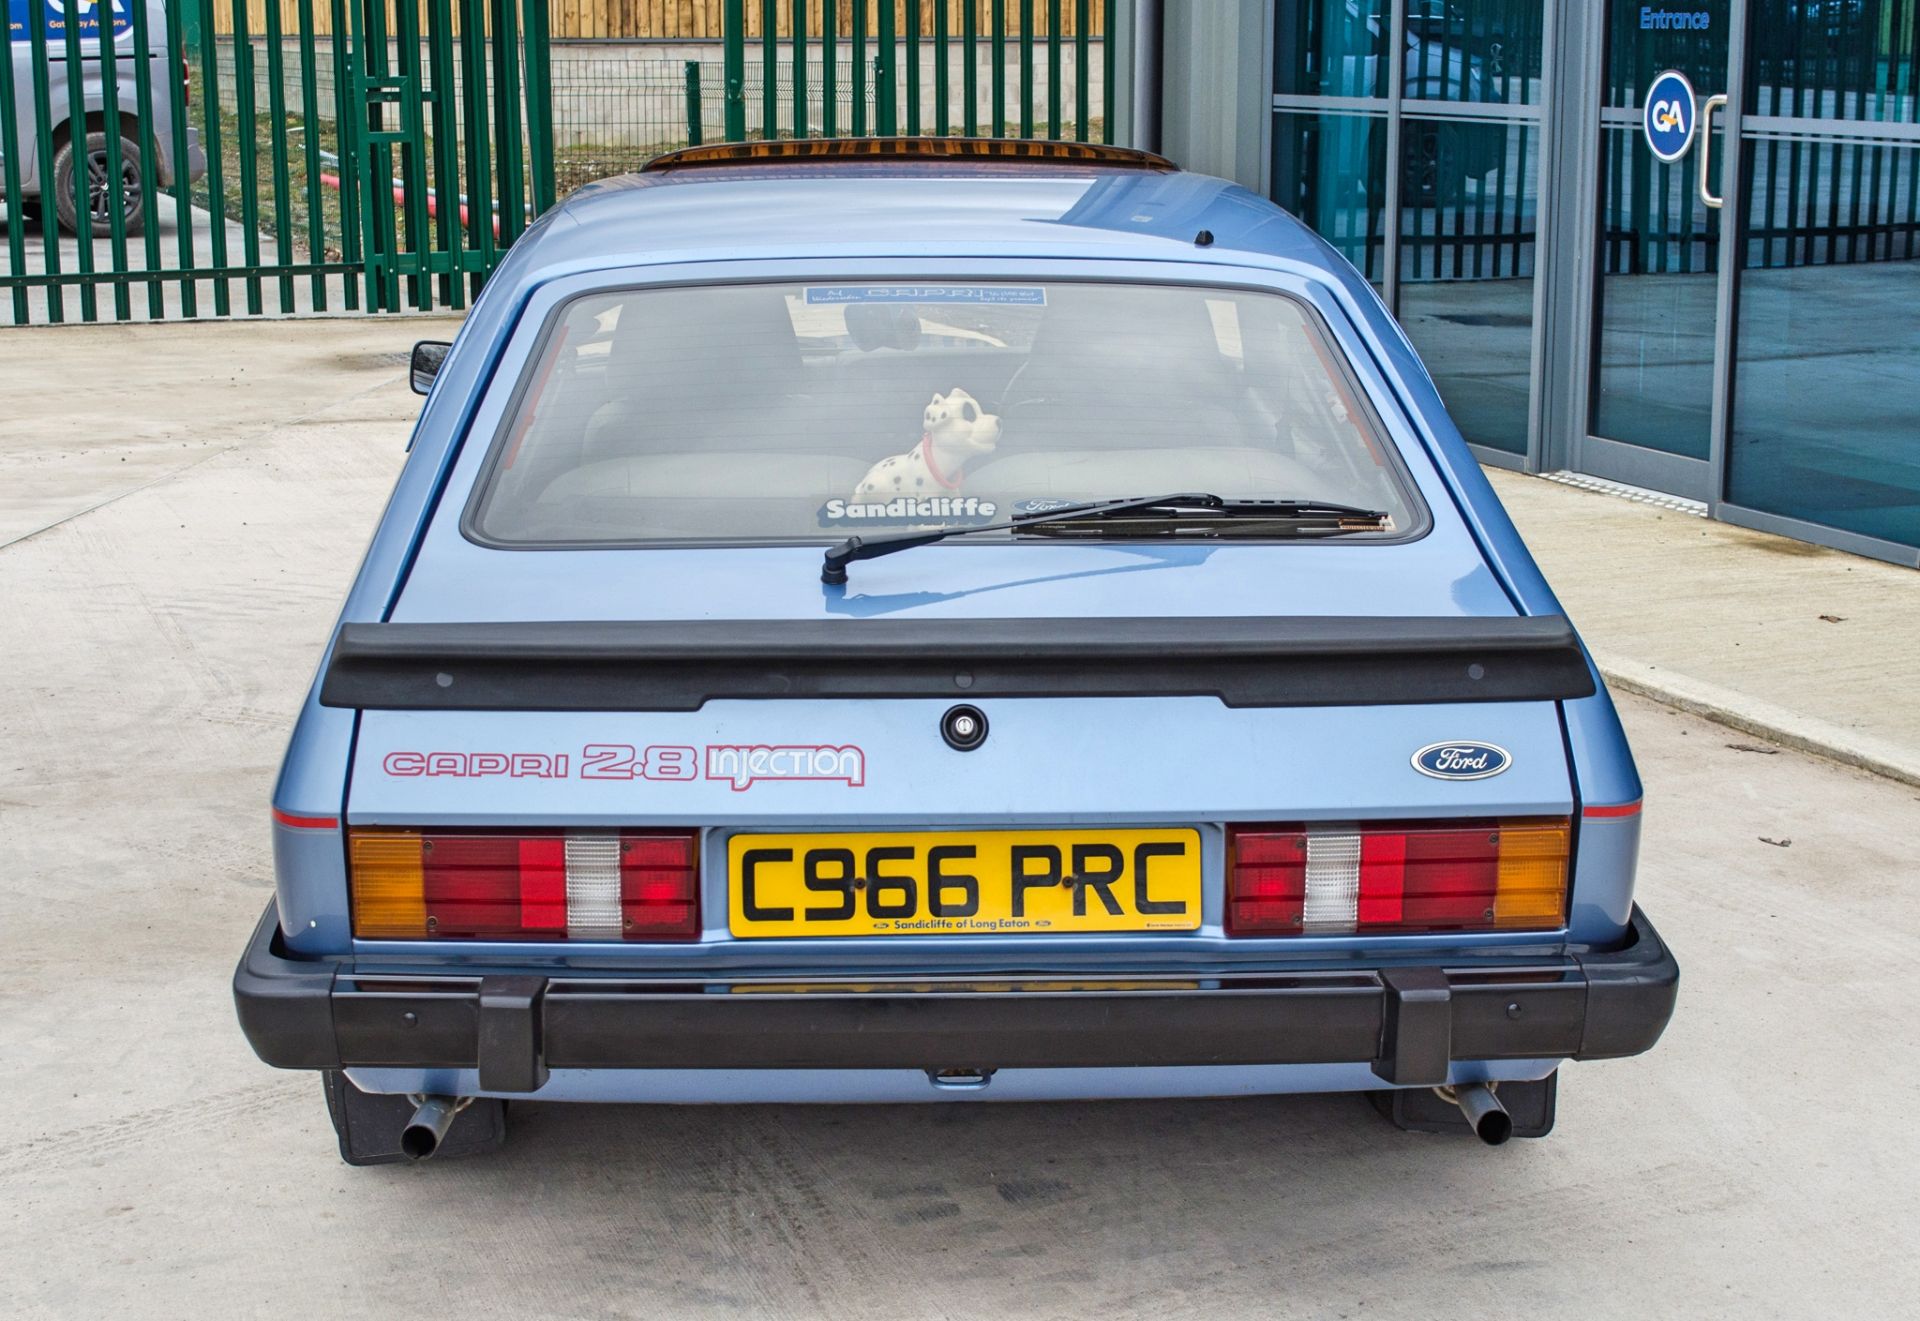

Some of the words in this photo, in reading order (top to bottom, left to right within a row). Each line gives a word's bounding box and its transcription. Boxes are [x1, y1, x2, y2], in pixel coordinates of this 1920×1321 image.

[1640, 6, 1710, 30] Entrance
[1652, 100, 1685, 134] GA
[826, 498, 996, 519] Sandicliffe
[383, 752, 569, 778] CAPRI
[1435, 748, 1488, 770] Ford
[742, 845, 980, 922] C966
[1011, 842, 1186, 916] PRC
[894, 919, 953, 929] Sandicliffe
[956, 919, 968, 928] of
[970, 919, 997, 930] Long
[999, 919, 1030, 928] Eaton
